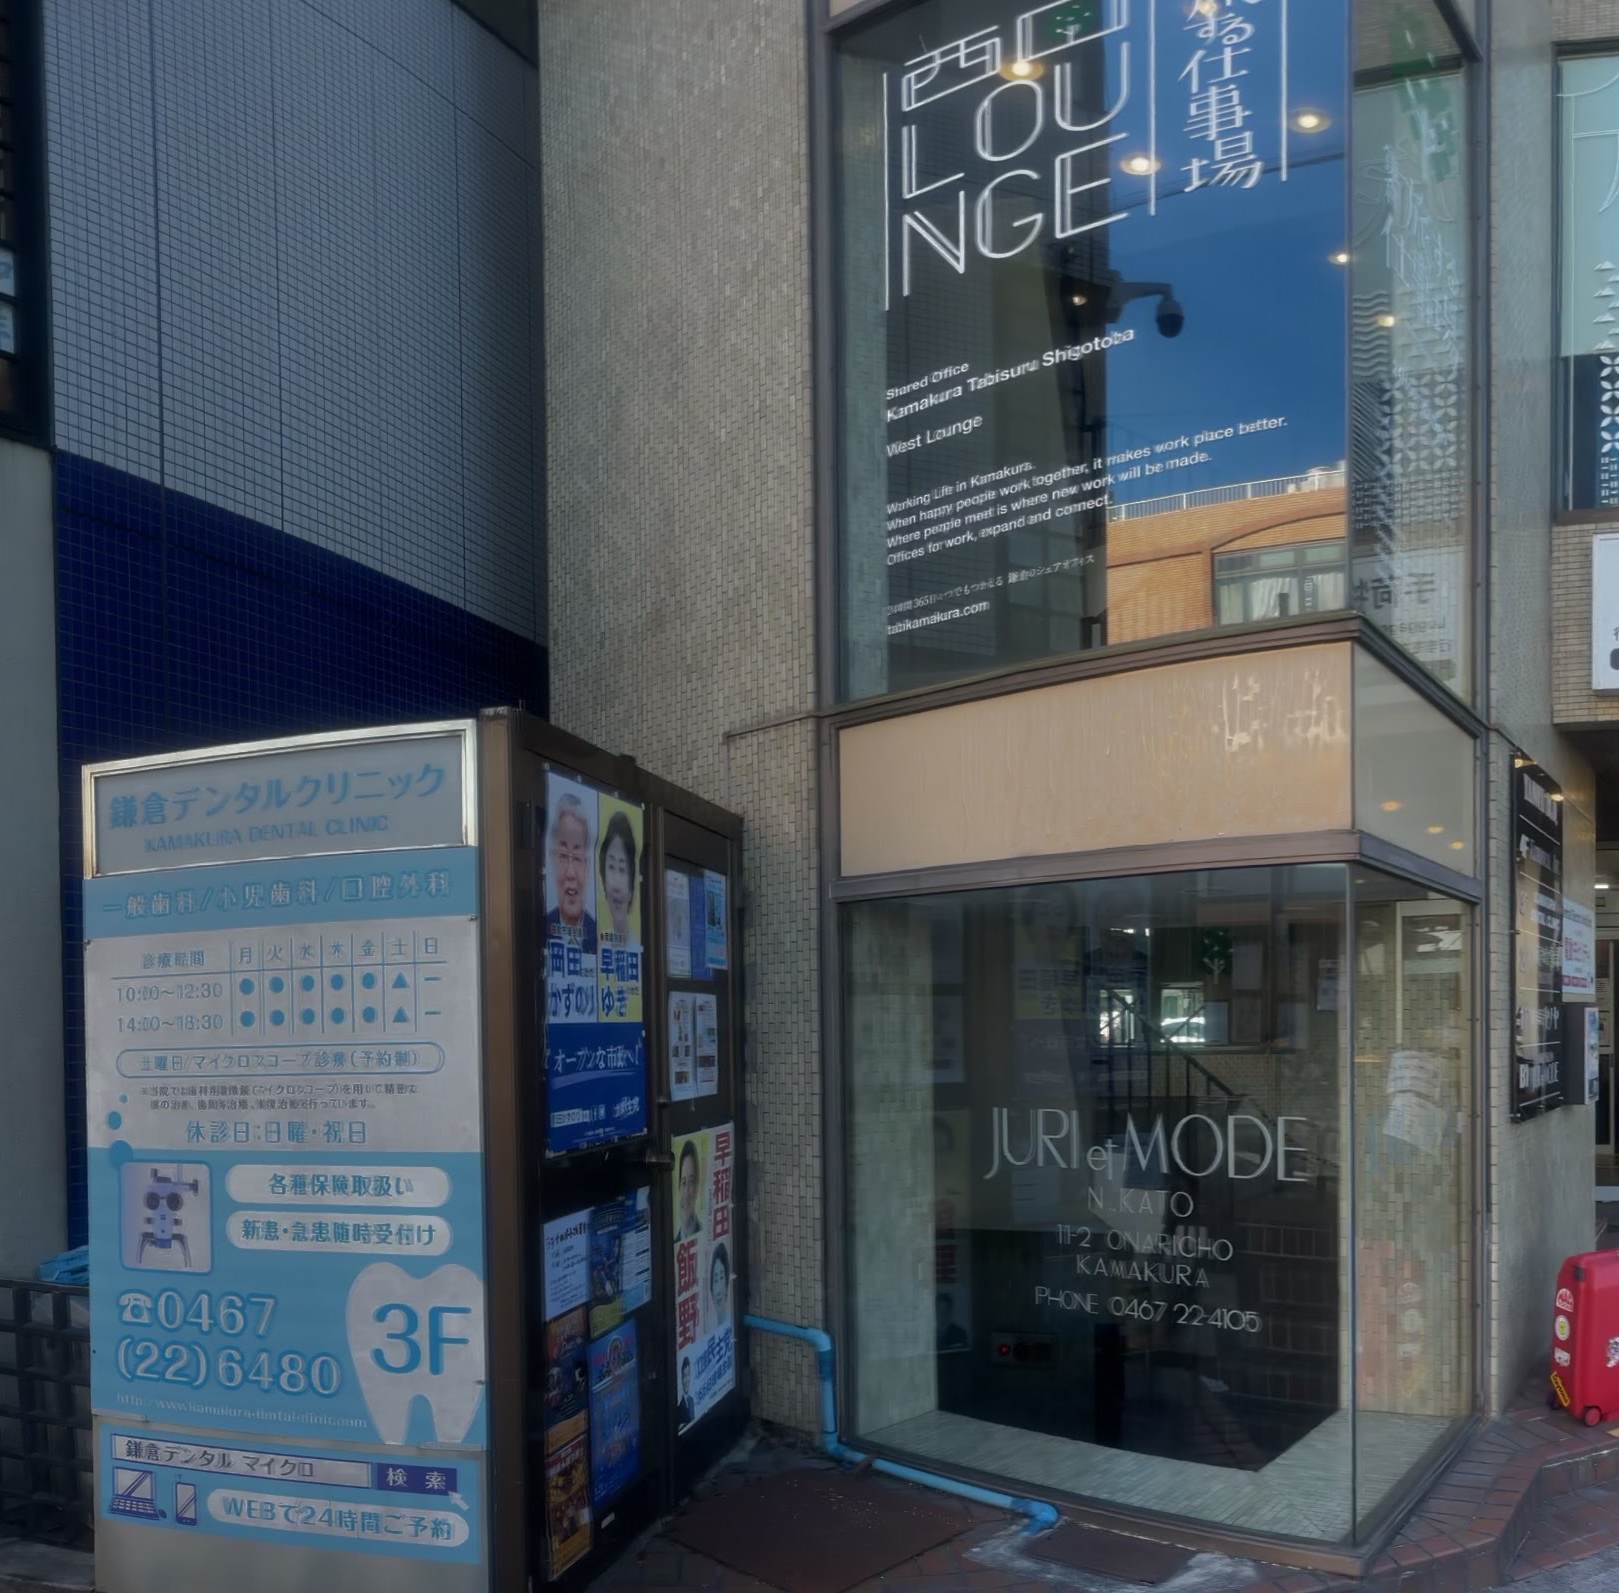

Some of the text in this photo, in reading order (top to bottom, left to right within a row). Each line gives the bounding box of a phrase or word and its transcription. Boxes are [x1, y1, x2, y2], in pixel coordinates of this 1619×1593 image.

[902, 42, 1131, 199] LOU
[902, 132, 1130, 296] NGE
[886, 328, 1135, 423] Kamakura Tabisuru Shigotoba
[886, 361, 970, 400] Shared Office
[886, 413, 983, 458] West Lounge
[886, 415, 1288, 531] When happy people work together, it makes work place better.
[886, 461, 1035, 514] Working Life in Kamakura.
[886, 451, 1212, 548] Where people meet is where new work will be made.
[886, 494, 1112, 566] Offices for work, expand and connect.
[886, 600, 991, 637] tabikamakura.com
[110, 763, 446, 829] 鎌倉デンタルクリニック
[147, 815, 389, 852] KAMAKURA DENTAL CLINIC
[142, 937, 438, 969] 診療時間 月 火 水 木 金 土 日
[549, 942, 581, 978] 岡田
[601, 948, 639, 982] 早稲田
[602, 985, 628, 1017] ゆき
[983, 1107, 1309, 1183] JURI et MODE
[268, 1173, 414, 1197] 各種保険取扱い
[713, 1130, 731, 1241] 早稲田
[1057, 1224, 1234, 1261] 11-2 ONARICHO
[1076, 1254, 1210, 1288] KAMAKURA
[156, 1290, 276, 1338] 0467
[677, 1238, 699, 1351] 飯野
[1035, 1286, 1263, 1333] PHONE 0467 22-4105
[370, 1302, 472, 1376] 3F
[125, 1439, 314, 1478] 鎌倉デンタル マイクロ
[386, 1468, 447, 1490] 検索
[222, 1496, 453, 1541] WEBで24時間ご予約
